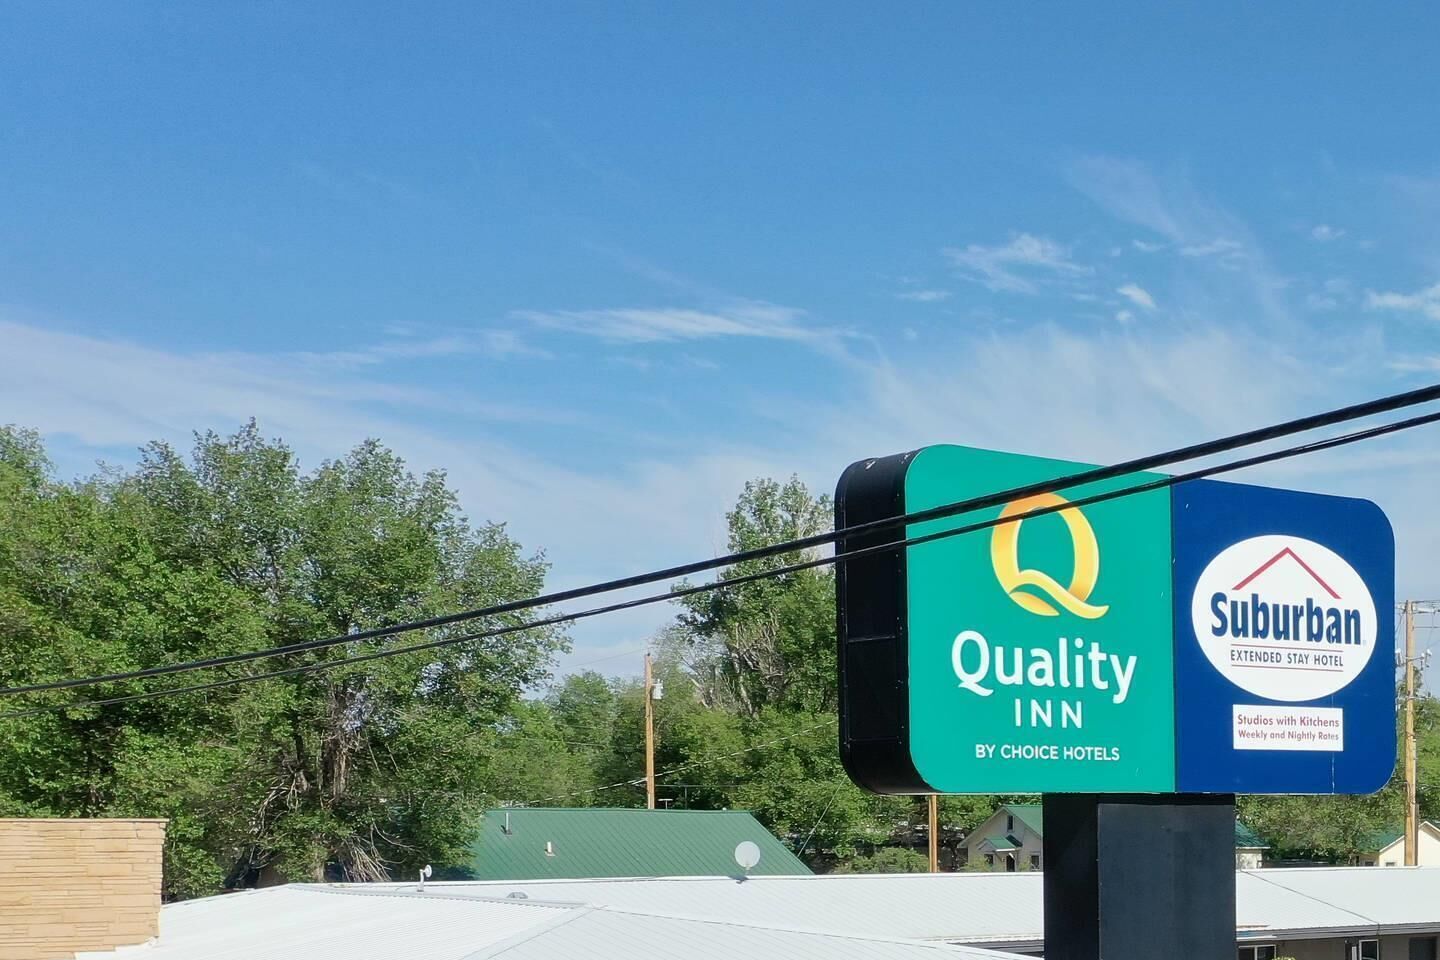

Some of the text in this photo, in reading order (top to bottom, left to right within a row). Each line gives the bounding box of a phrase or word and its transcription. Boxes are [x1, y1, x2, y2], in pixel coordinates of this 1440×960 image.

[990, 492, 1110, 619] Q
[1210, 591, 1361, 645] Suburban
[951, 630, 1137, 704] Quality
[1230, 649, 1344, 667] EXTENDED STAY HOTEL
[1015, 698, 1083, 729] INN
[1237, 714, 1340, 728] Studios with Kitchens
[1238, 729, 1340, 742] Weekly and Nightly Rates
[975, 744, 1121, 761] BY CHOICE HOTELS
